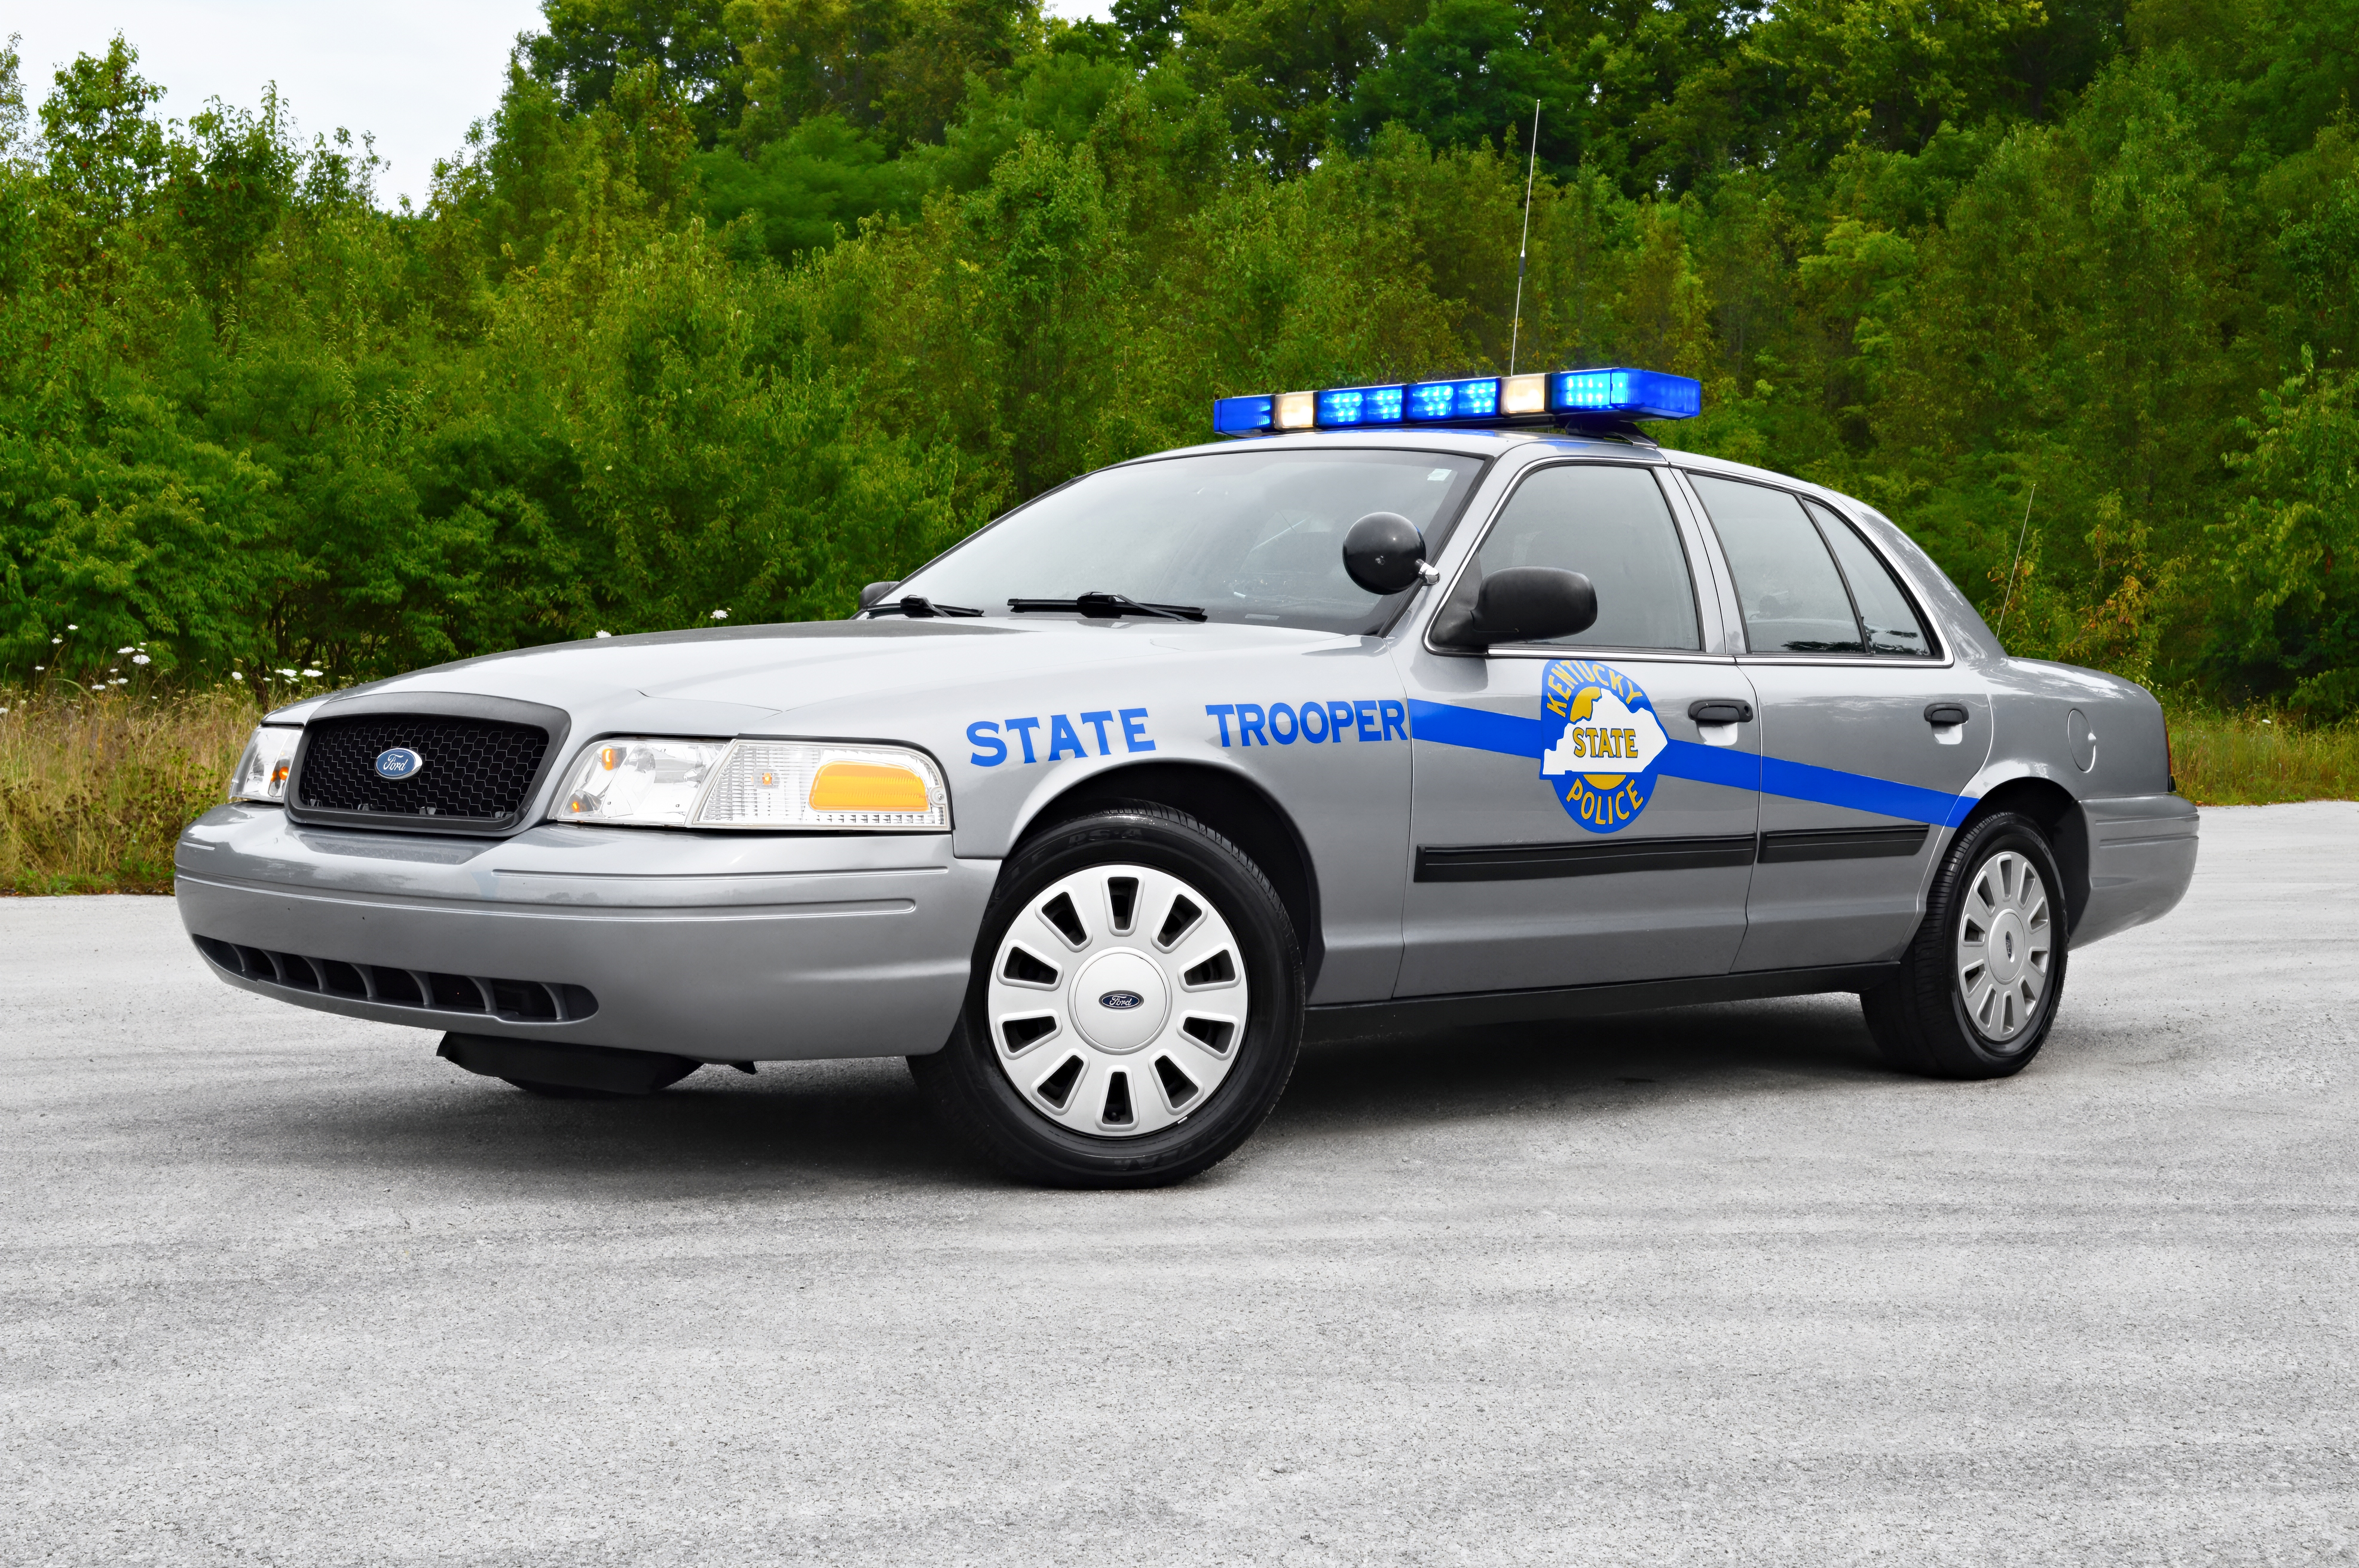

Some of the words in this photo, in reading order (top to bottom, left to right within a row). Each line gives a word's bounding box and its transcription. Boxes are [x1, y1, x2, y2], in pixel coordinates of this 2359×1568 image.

[1547, 660, 1643, 718] KENTUCKY
[966, 708, 1156, 767] STATE
[1205, 700, 1408, 747] TROOPER
[1572, 727, 1638, 758] STATE
[383, 754, 408, 771] Ford
[1566, 778, 1644, 825] POLICE
[1109, 996, 1132, 1006] Ford
